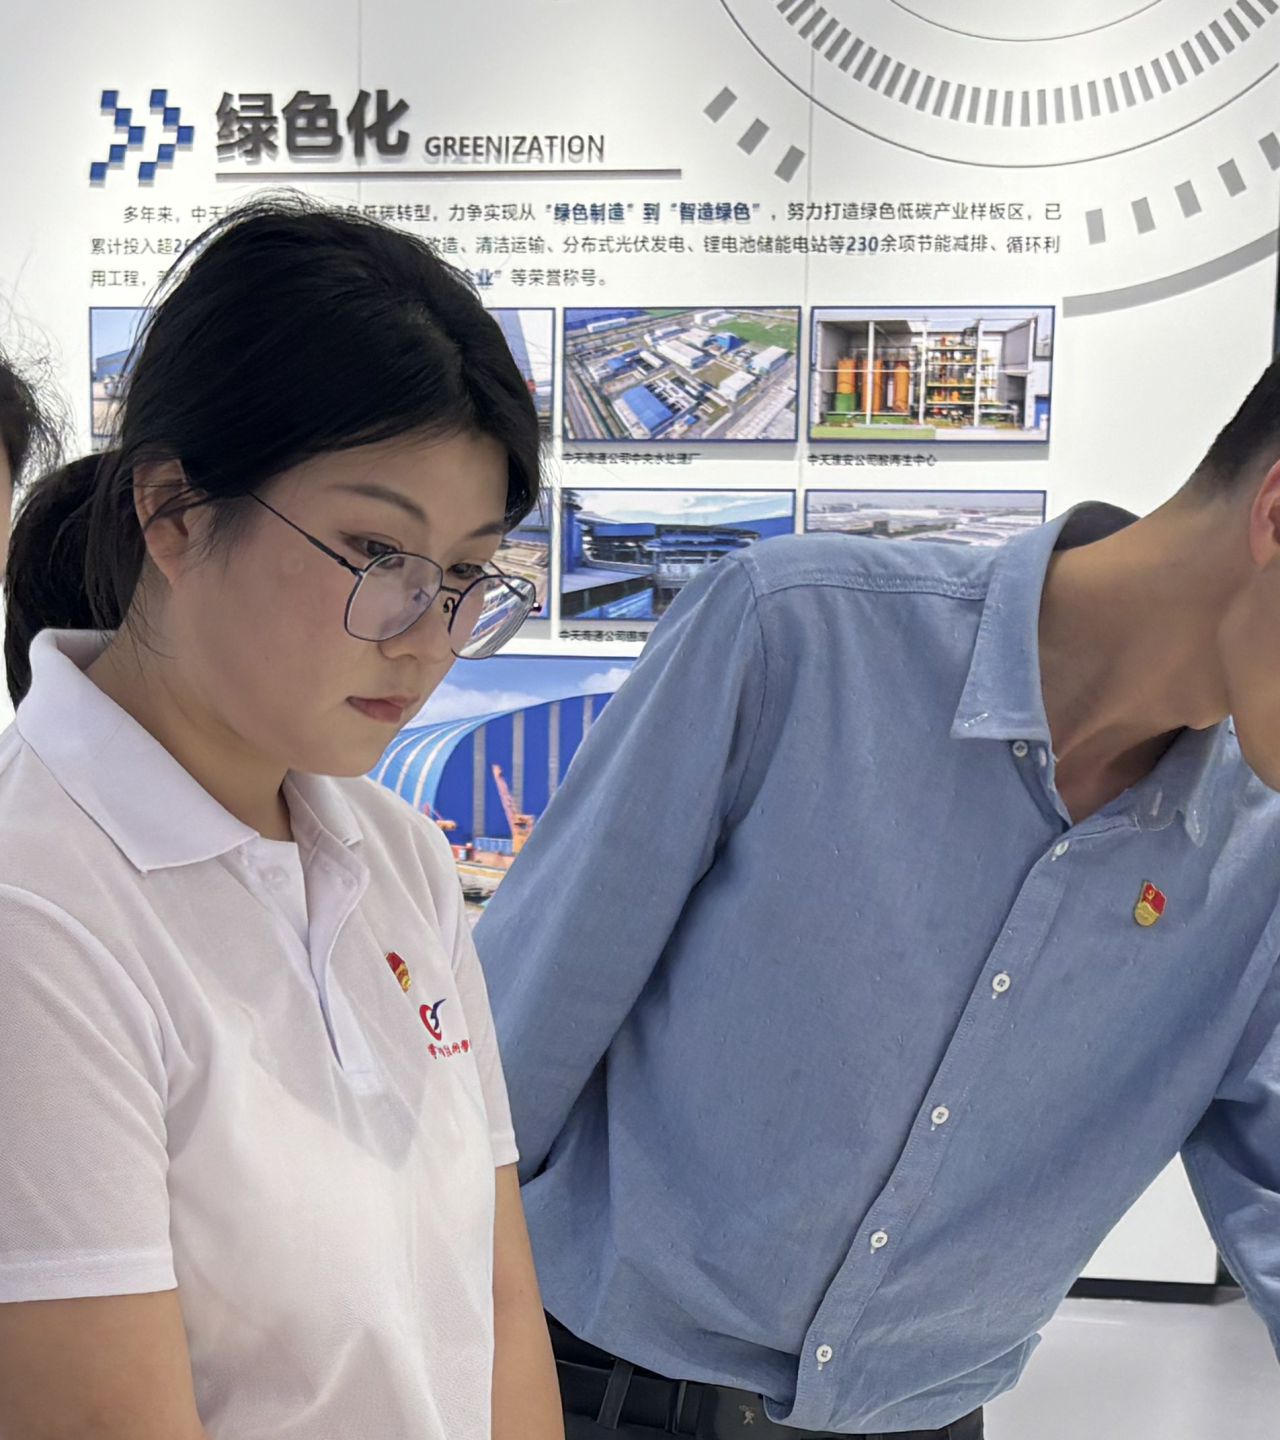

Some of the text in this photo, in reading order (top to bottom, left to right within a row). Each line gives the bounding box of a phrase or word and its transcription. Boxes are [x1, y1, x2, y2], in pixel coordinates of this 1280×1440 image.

[216, 89, 410, 158] 绿色化
[424, 134, 605, 158] GREENIZATION
